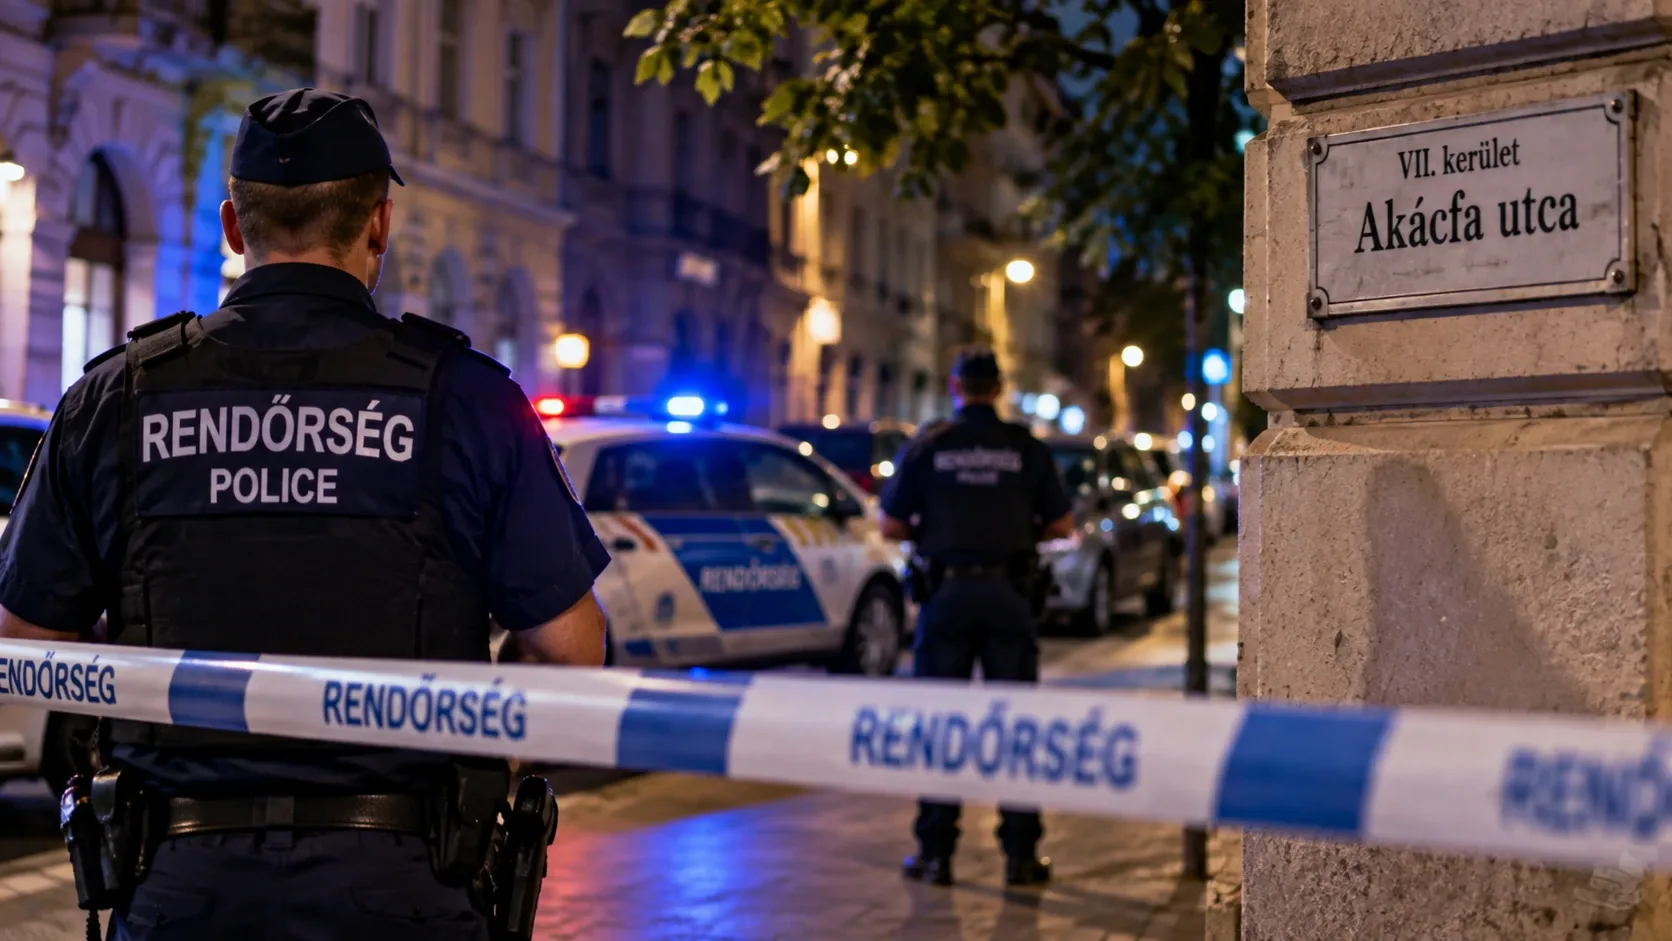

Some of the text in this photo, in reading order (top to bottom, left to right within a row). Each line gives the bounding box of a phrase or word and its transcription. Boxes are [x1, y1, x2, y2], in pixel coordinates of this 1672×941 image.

[1398, 137, 1520, 179] VII. kerület
[1354, 187, 1580, 253] Akácfa utca
[142, 394, 414, 462] RENDŐRSÉG
[210, 467, 338, 503] POLICE
[322, 673, 528, 741] RENDŐRSÉG
